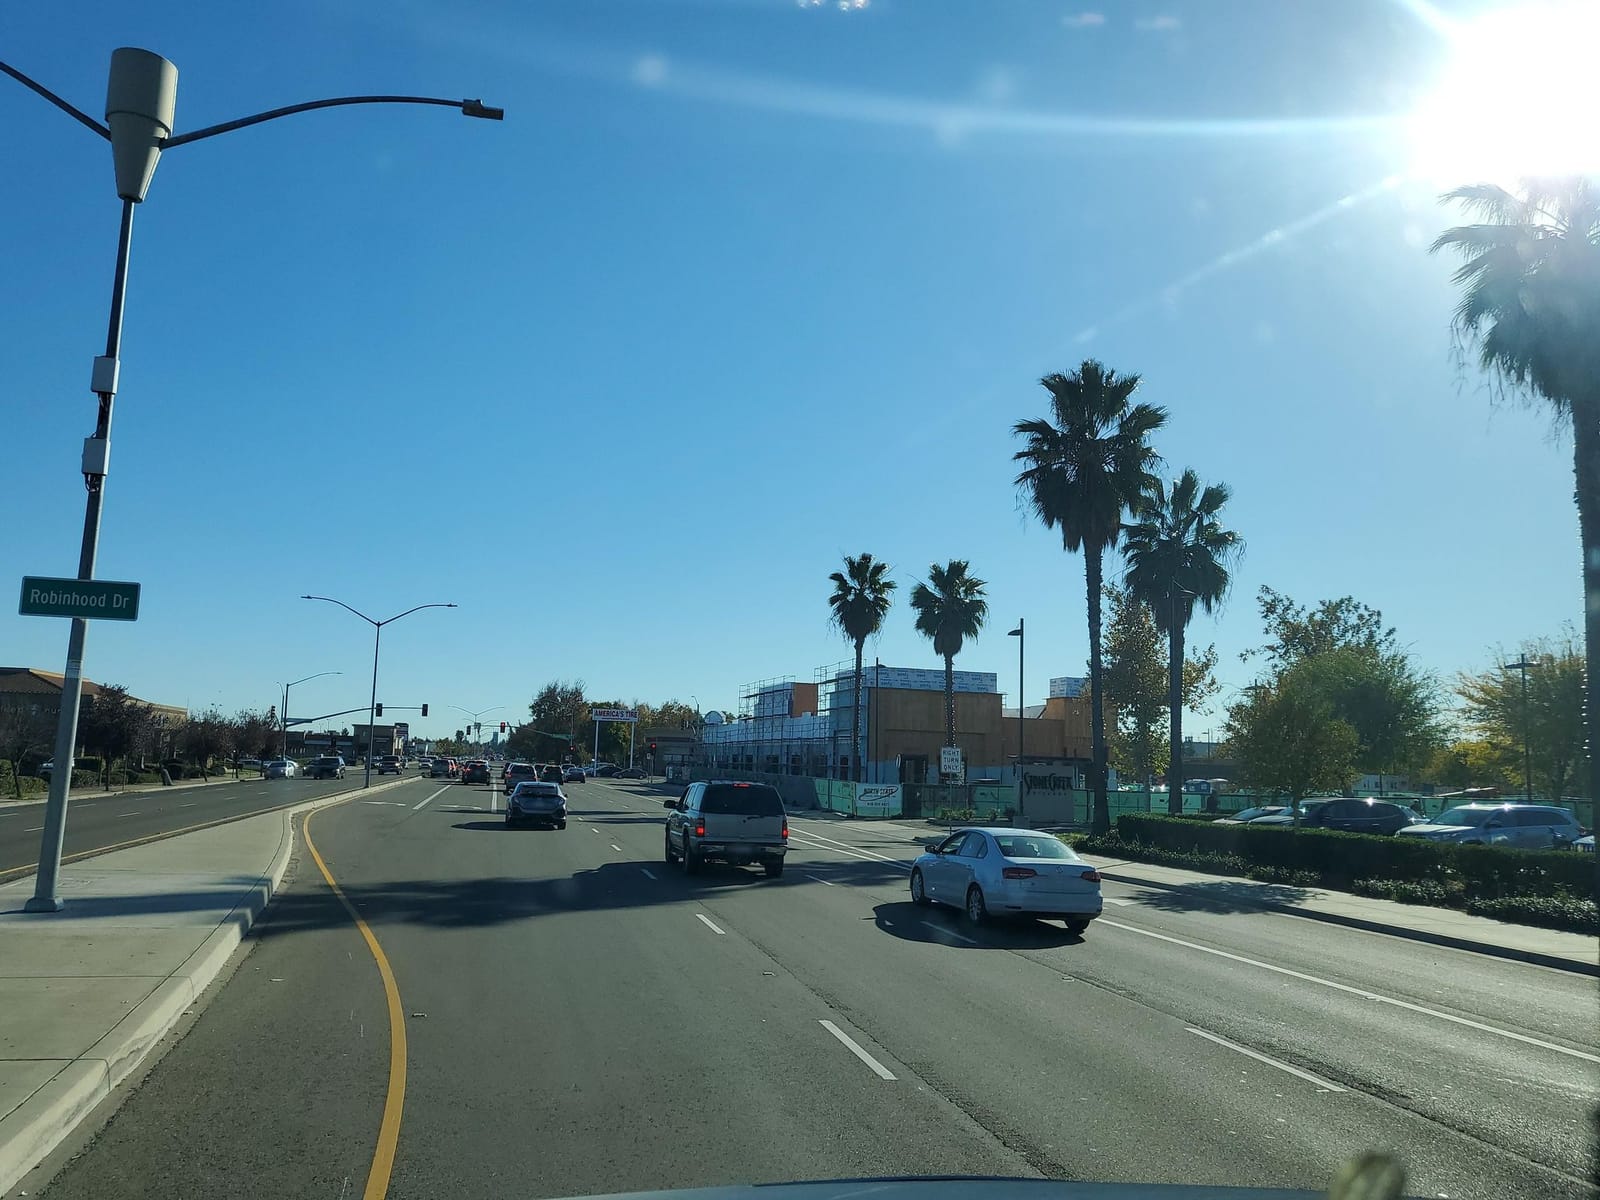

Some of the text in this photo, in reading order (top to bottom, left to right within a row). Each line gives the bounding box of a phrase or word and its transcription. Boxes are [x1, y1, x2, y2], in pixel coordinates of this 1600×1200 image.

[30, 588, 130, 609] Robinhood Dr
[595, 710, 625, 718] AMERICA'S
